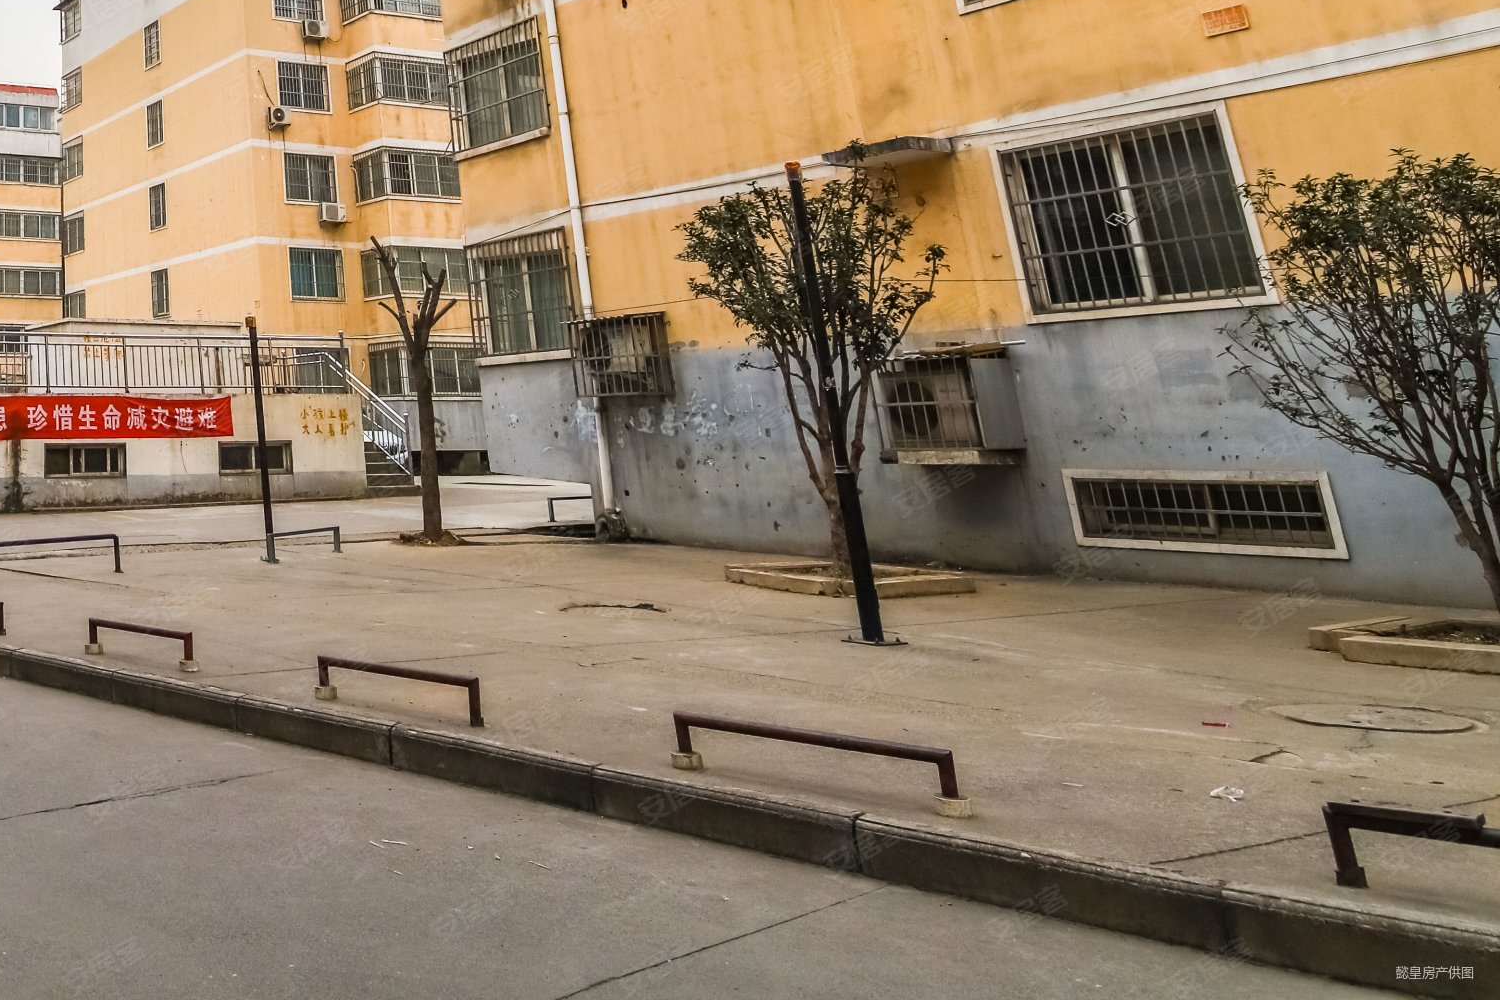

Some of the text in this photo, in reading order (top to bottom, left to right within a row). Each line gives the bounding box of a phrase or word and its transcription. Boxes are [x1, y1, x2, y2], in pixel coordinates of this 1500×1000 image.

[26, 403, 218, 432] 珍惜生命减灾避难
